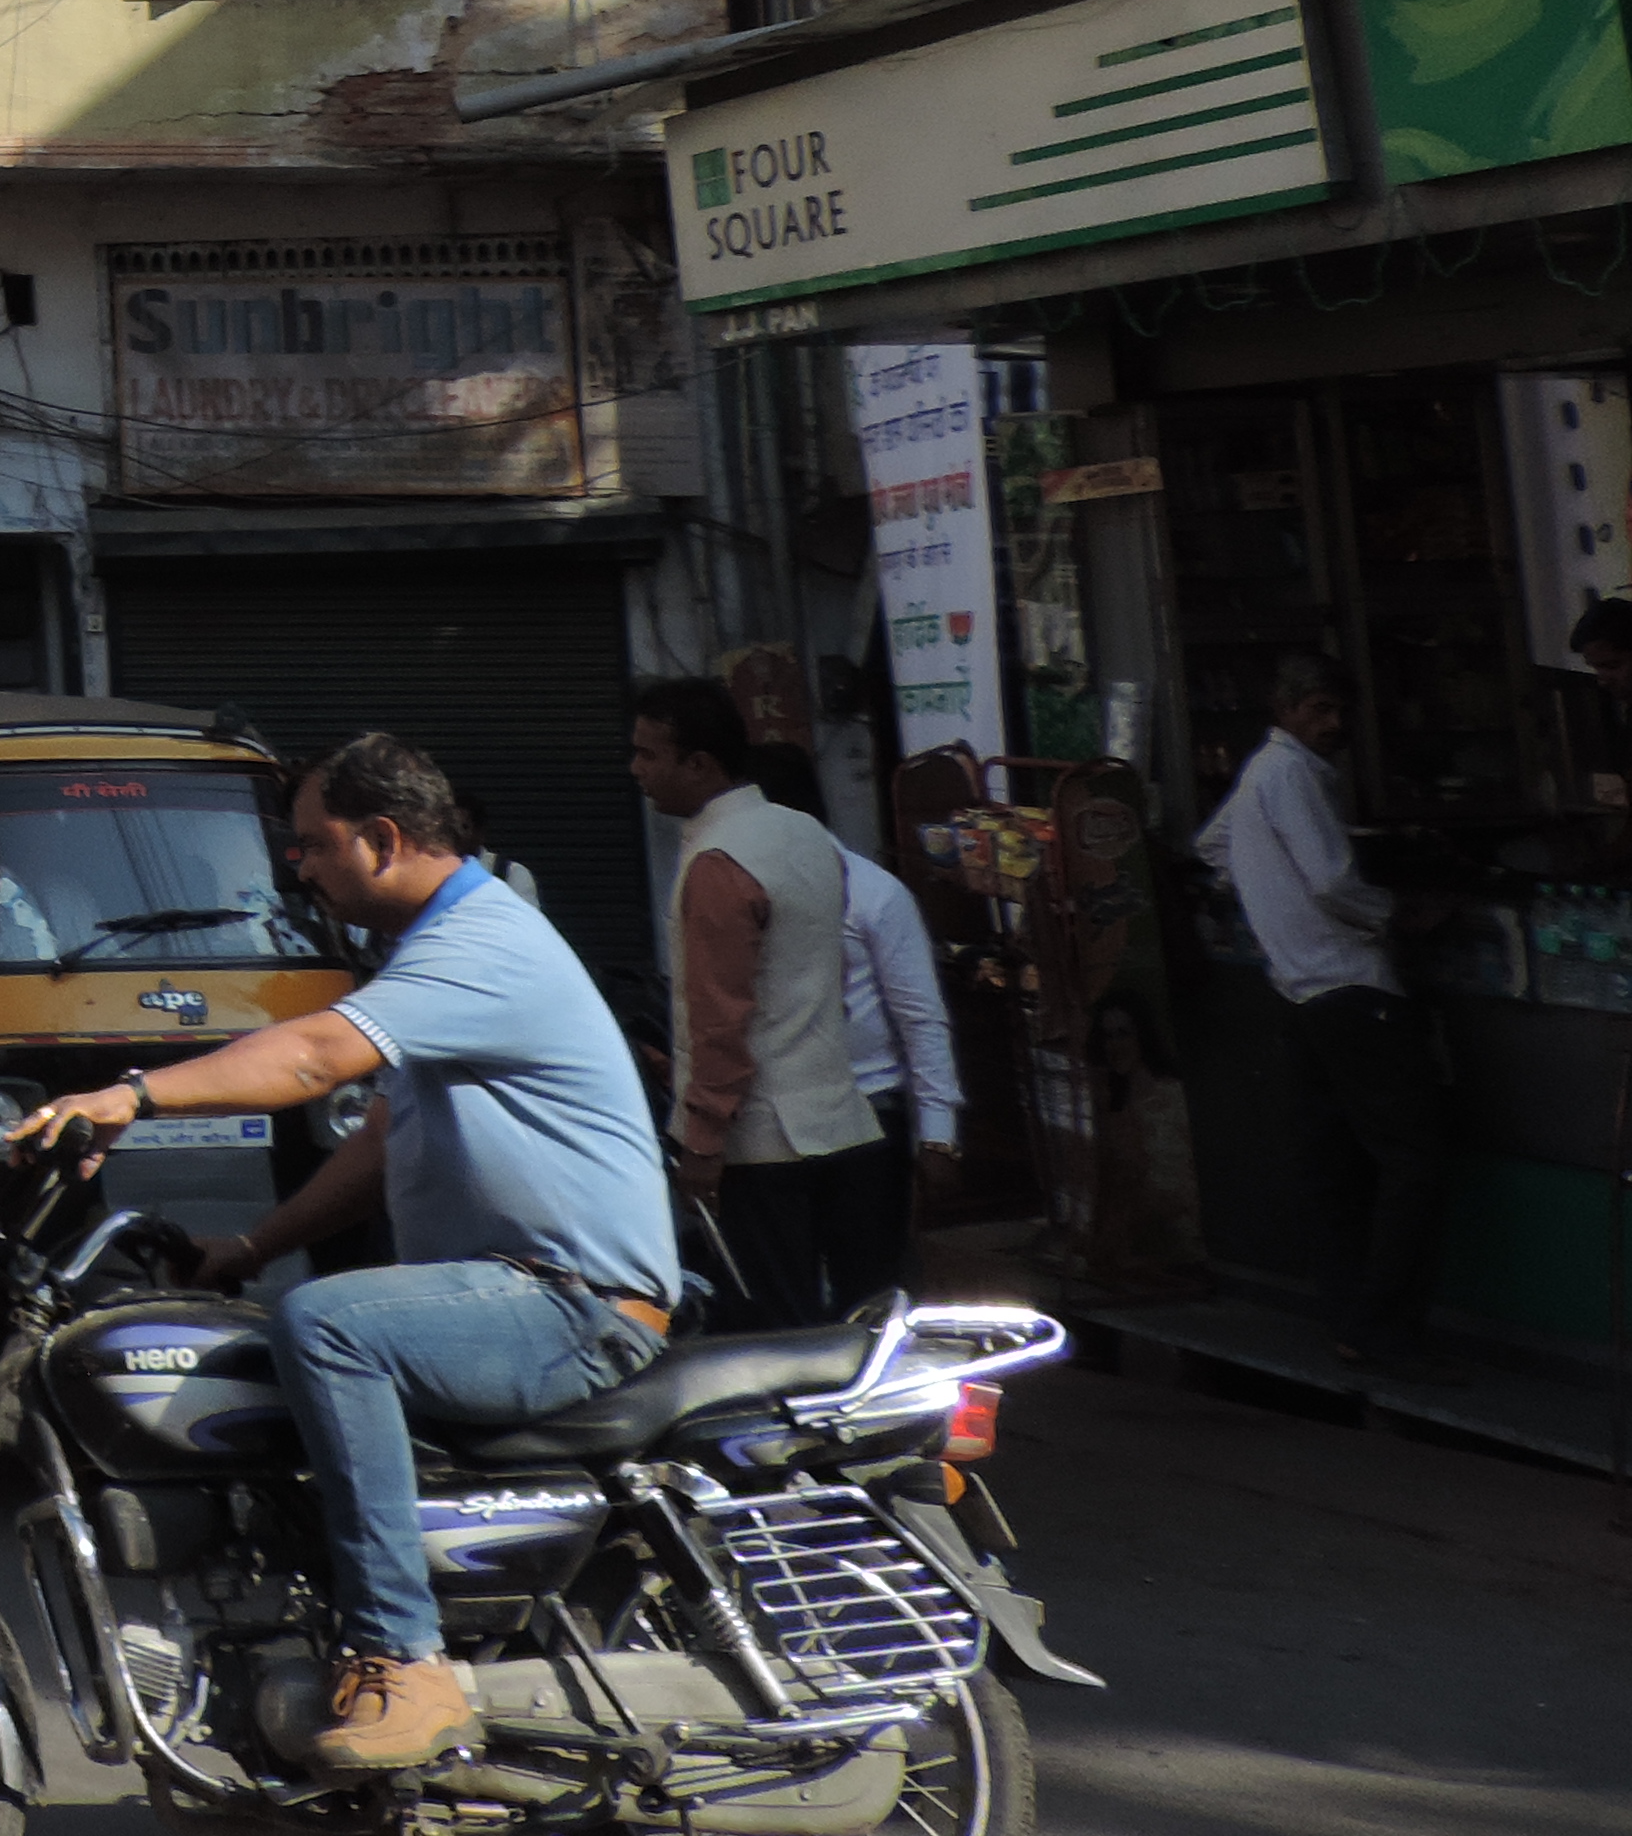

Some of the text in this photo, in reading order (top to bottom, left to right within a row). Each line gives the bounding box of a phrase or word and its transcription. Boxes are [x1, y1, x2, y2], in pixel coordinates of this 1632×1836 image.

[731, 130, 832, 194] FOUR
[707, 189, 849, 260] SQUARE
[124, 285, 555, 370] Sunbright
[130, 376, 295, 422] LAUNDRY
[140, 991, 204, 1010] ape
[124, 1345, 198, 1371] Hero
